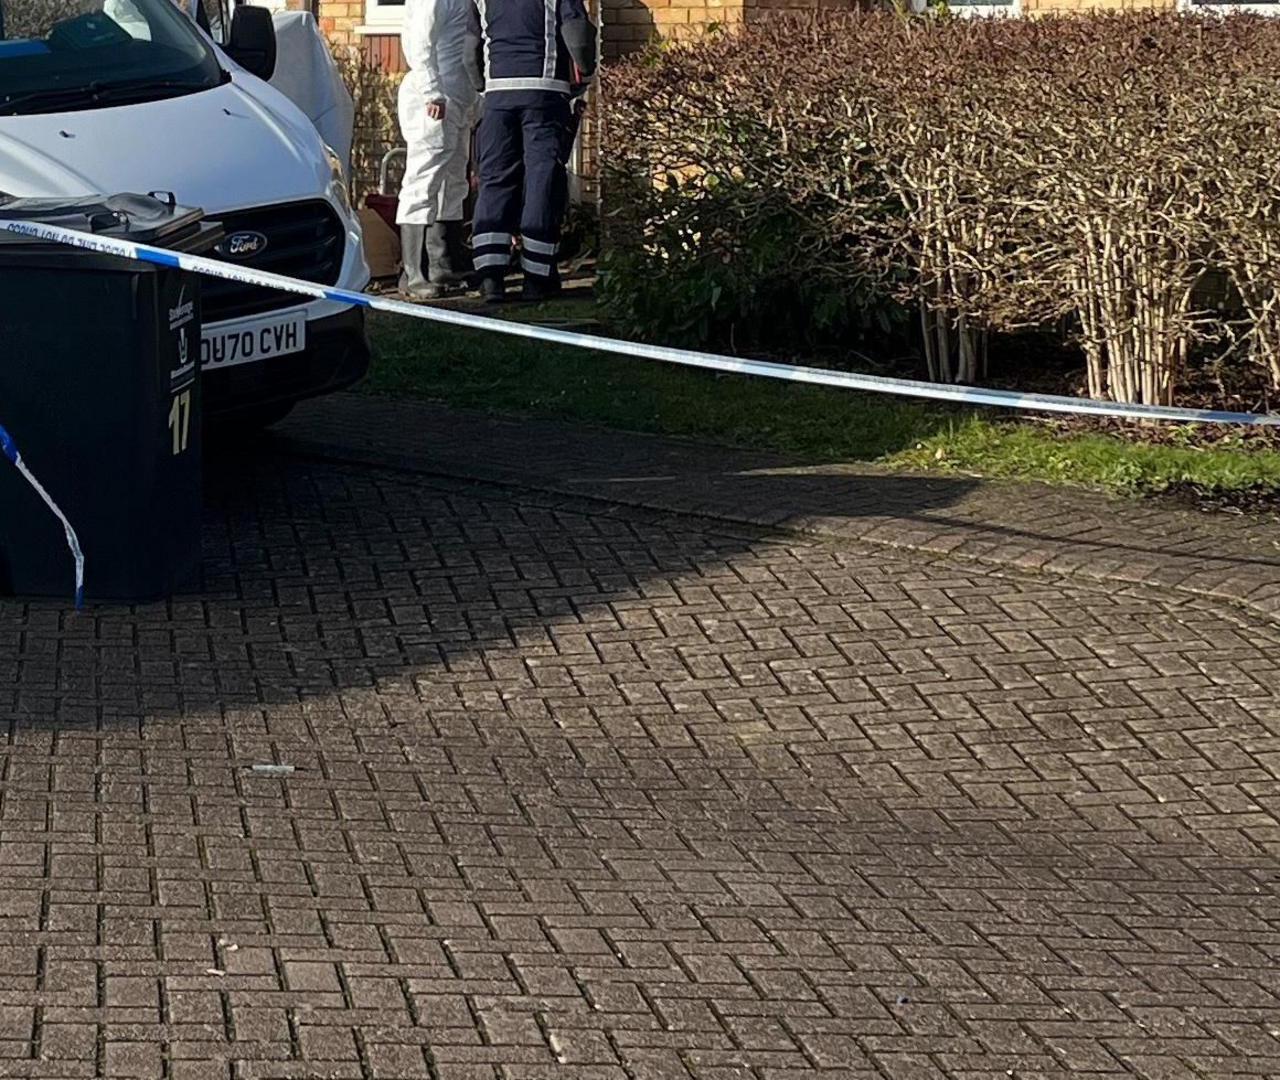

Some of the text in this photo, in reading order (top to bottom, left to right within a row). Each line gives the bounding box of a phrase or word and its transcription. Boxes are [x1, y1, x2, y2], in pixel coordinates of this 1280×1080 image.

[230, 235, 258, 253] Ford
[260, 322, 297, 354] CVH
[169, 389, 190, 455] 17
